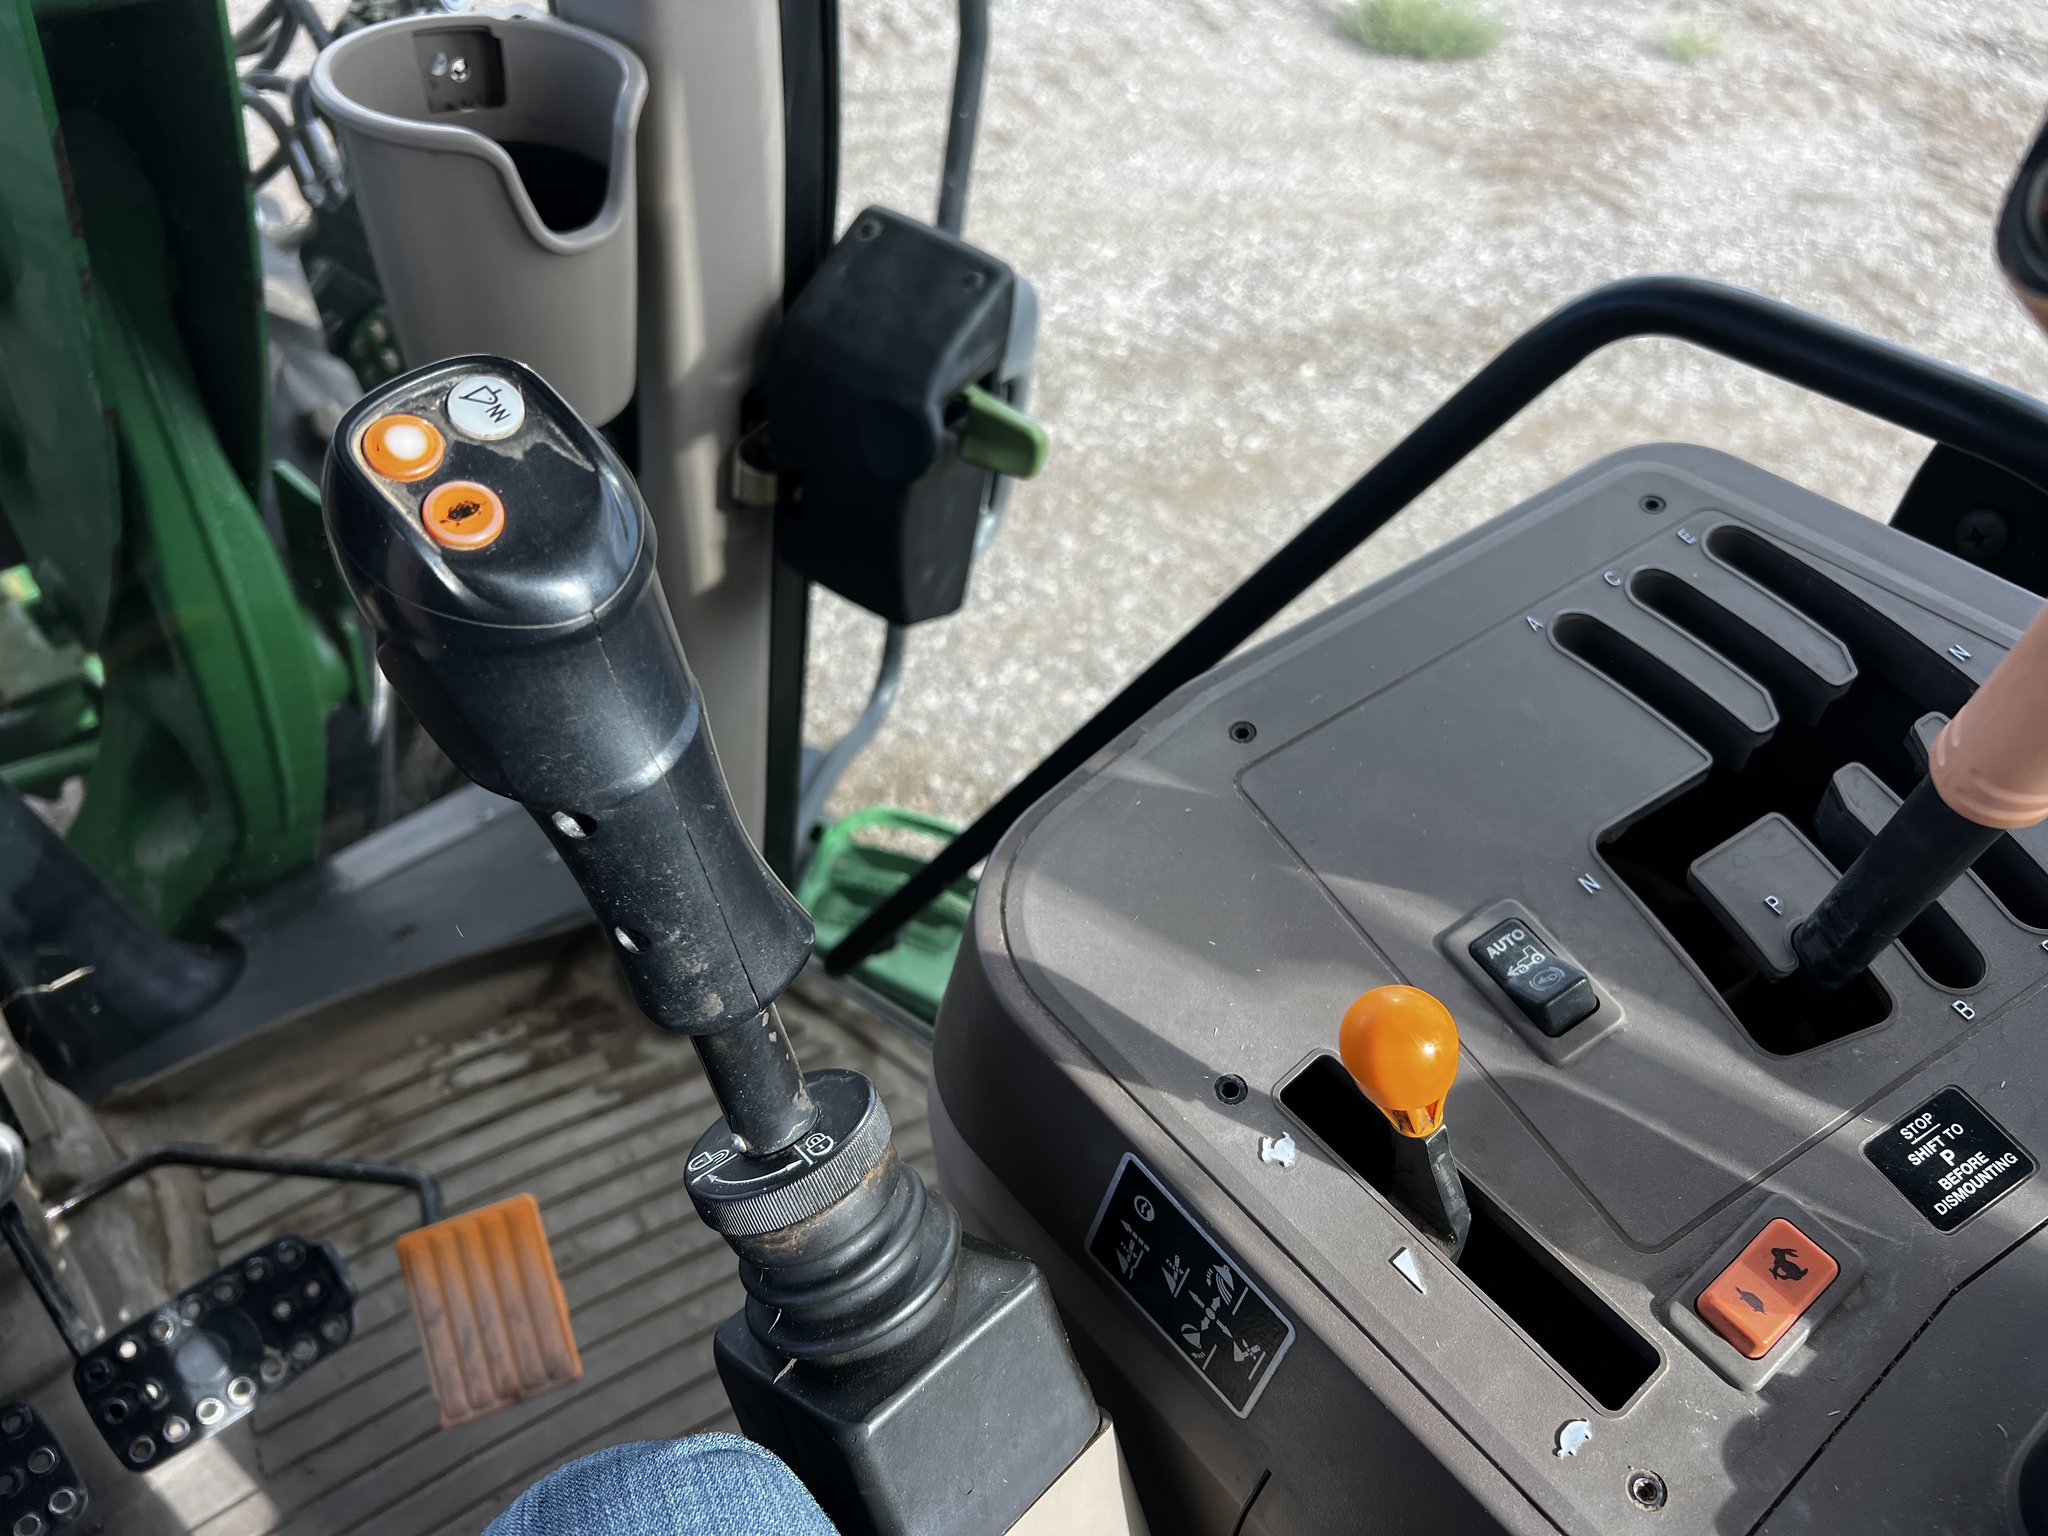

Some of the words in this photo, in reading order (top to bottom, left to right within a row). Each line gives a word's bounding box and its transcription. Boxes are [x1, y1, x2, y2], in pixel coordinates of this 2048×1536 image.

[1677, 528, 1697, 544] E
[1604, 570, 1621, 586] C
[1526, 616, 1544, 632] A
[1949, 644, 1971, 661] N
[1578, 873, 1600, 894] N
[1764, 895, 1782, 915] P
[1486, 929, 1525, 959] AUTO
[1952, 1000, 1975, 1020] B
[1900, 1112, 1934, 1140] STOP
[1907, 1135, 1945, 1166] SHIFT
[1942, 1123, 1964, 1140] TO
[1939, 1149, 1956, 1167] P
[1937, 1151, 1990, 1191] BEFORE
[1933, 1152, 2018, 1215] DISMOUNTING
